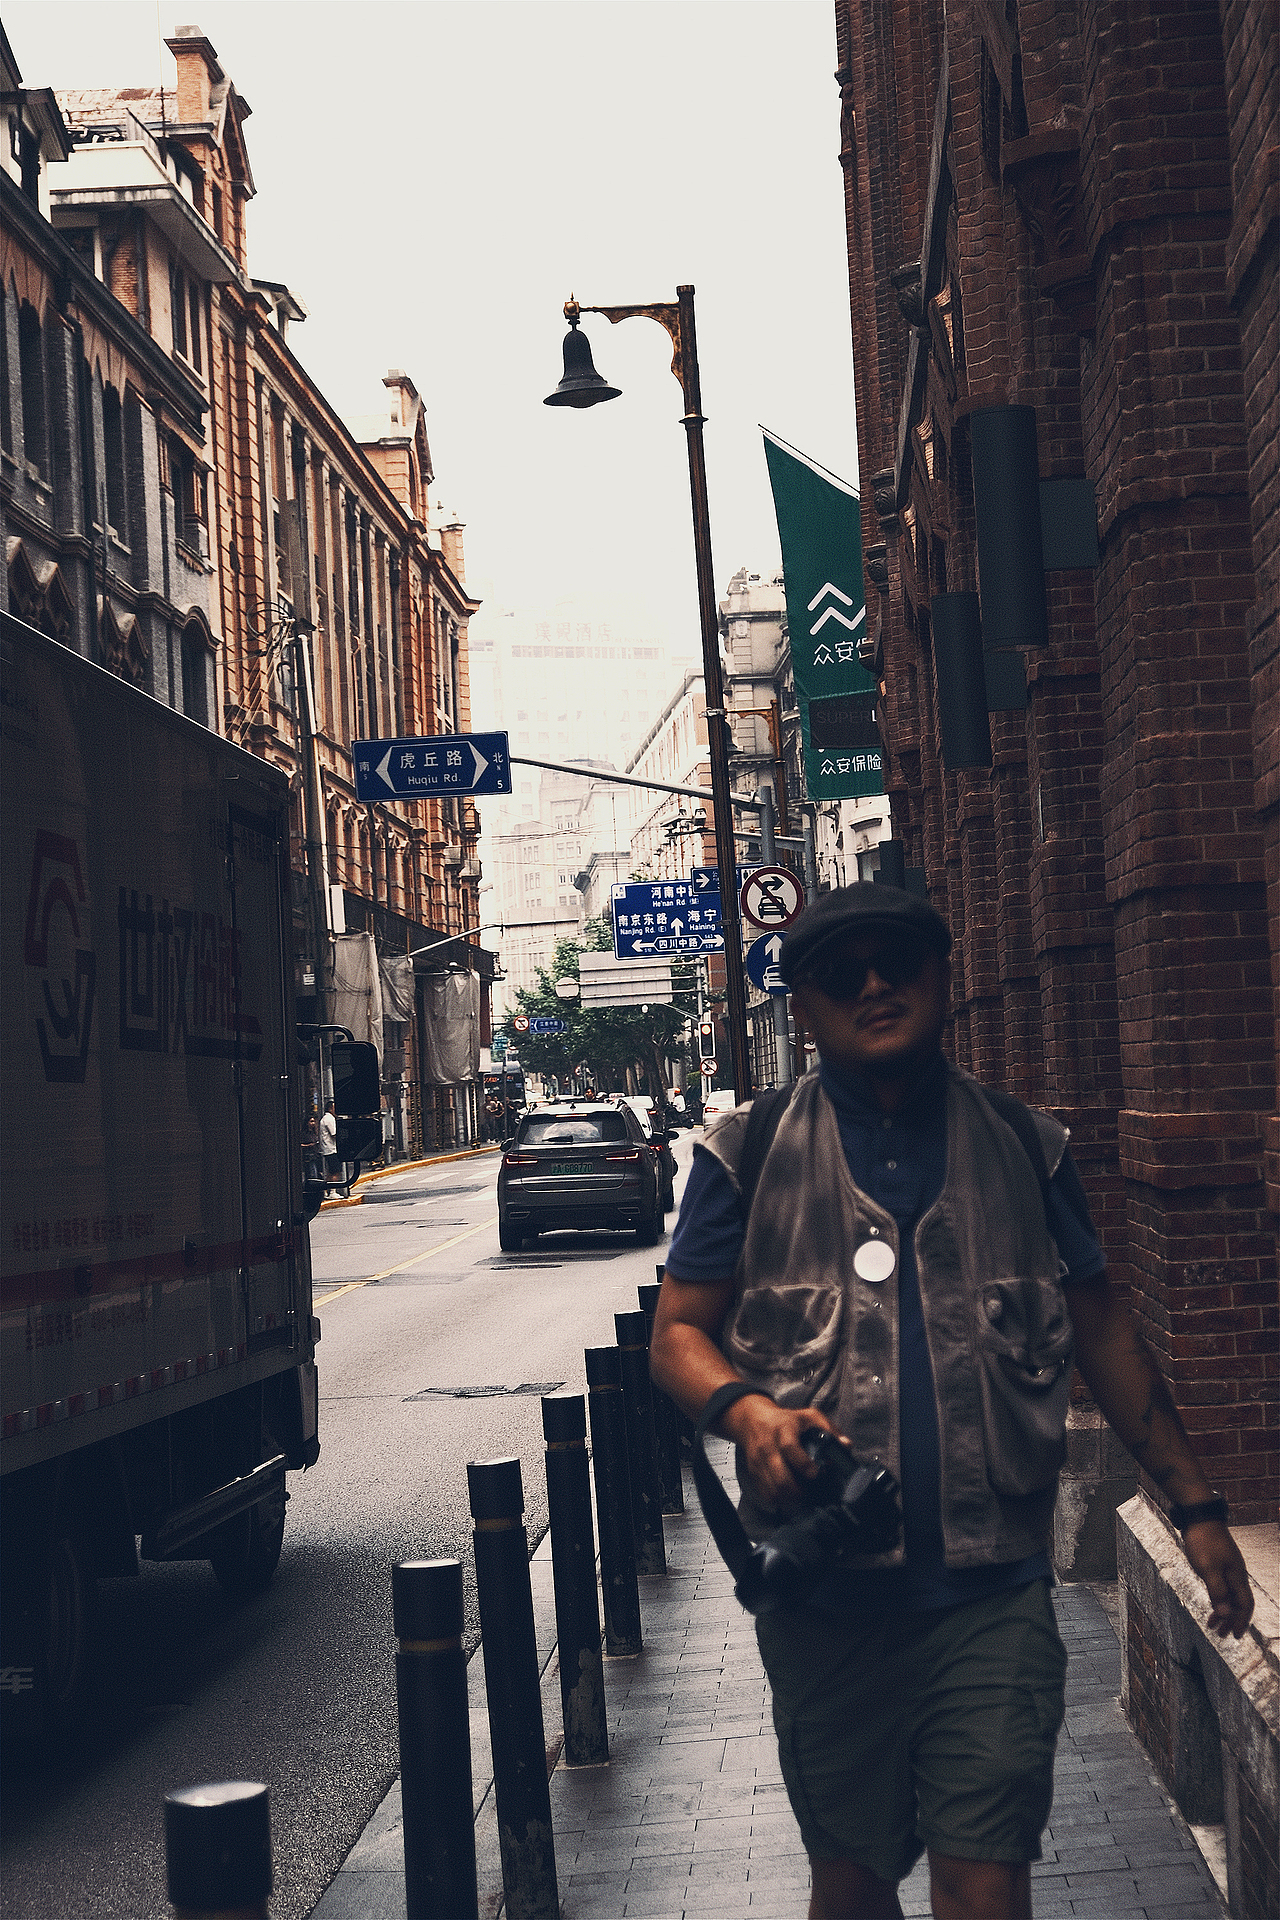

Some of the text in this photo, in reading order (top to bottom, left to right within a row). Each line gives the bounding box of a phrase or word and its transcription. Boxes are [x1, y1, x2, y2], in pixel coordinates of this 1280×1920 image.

[813, 637, 869, 666] 众安
[400, 750, 463, 769] 虎丘路
[493, 752, 503, 763] 北
[820, 753, 882, 775] 众安保险
[359, 761, 370, 772] 南
[408, 773, 461, 786] Huqiu Rd.
[618, 912, 668, 927] 南京东路
[620, 927, 643, 936] Nanjing
[689, 923, 716, 931] Haining
[658, 938, 698, 949] 四川中路
[0, 1666, 34, 1694] 车
